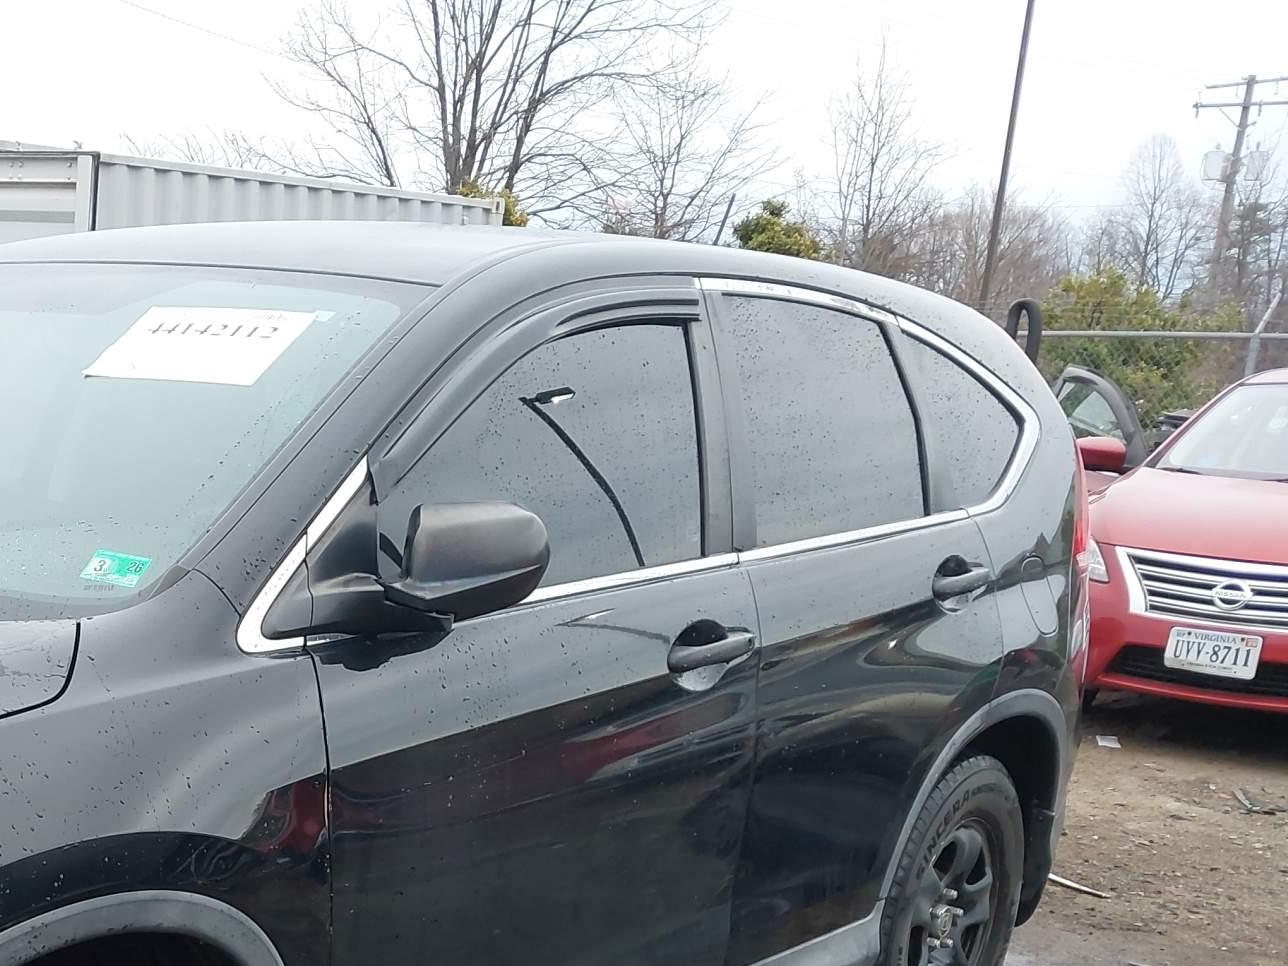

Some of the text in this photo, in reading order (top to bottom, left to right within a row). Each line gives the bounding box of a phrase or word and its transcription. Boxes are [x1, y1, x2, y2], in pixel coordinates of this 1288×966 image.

[93, 559, 144, 573] 3 26
[1194, 632, 1237, 645] VIRGINIA
